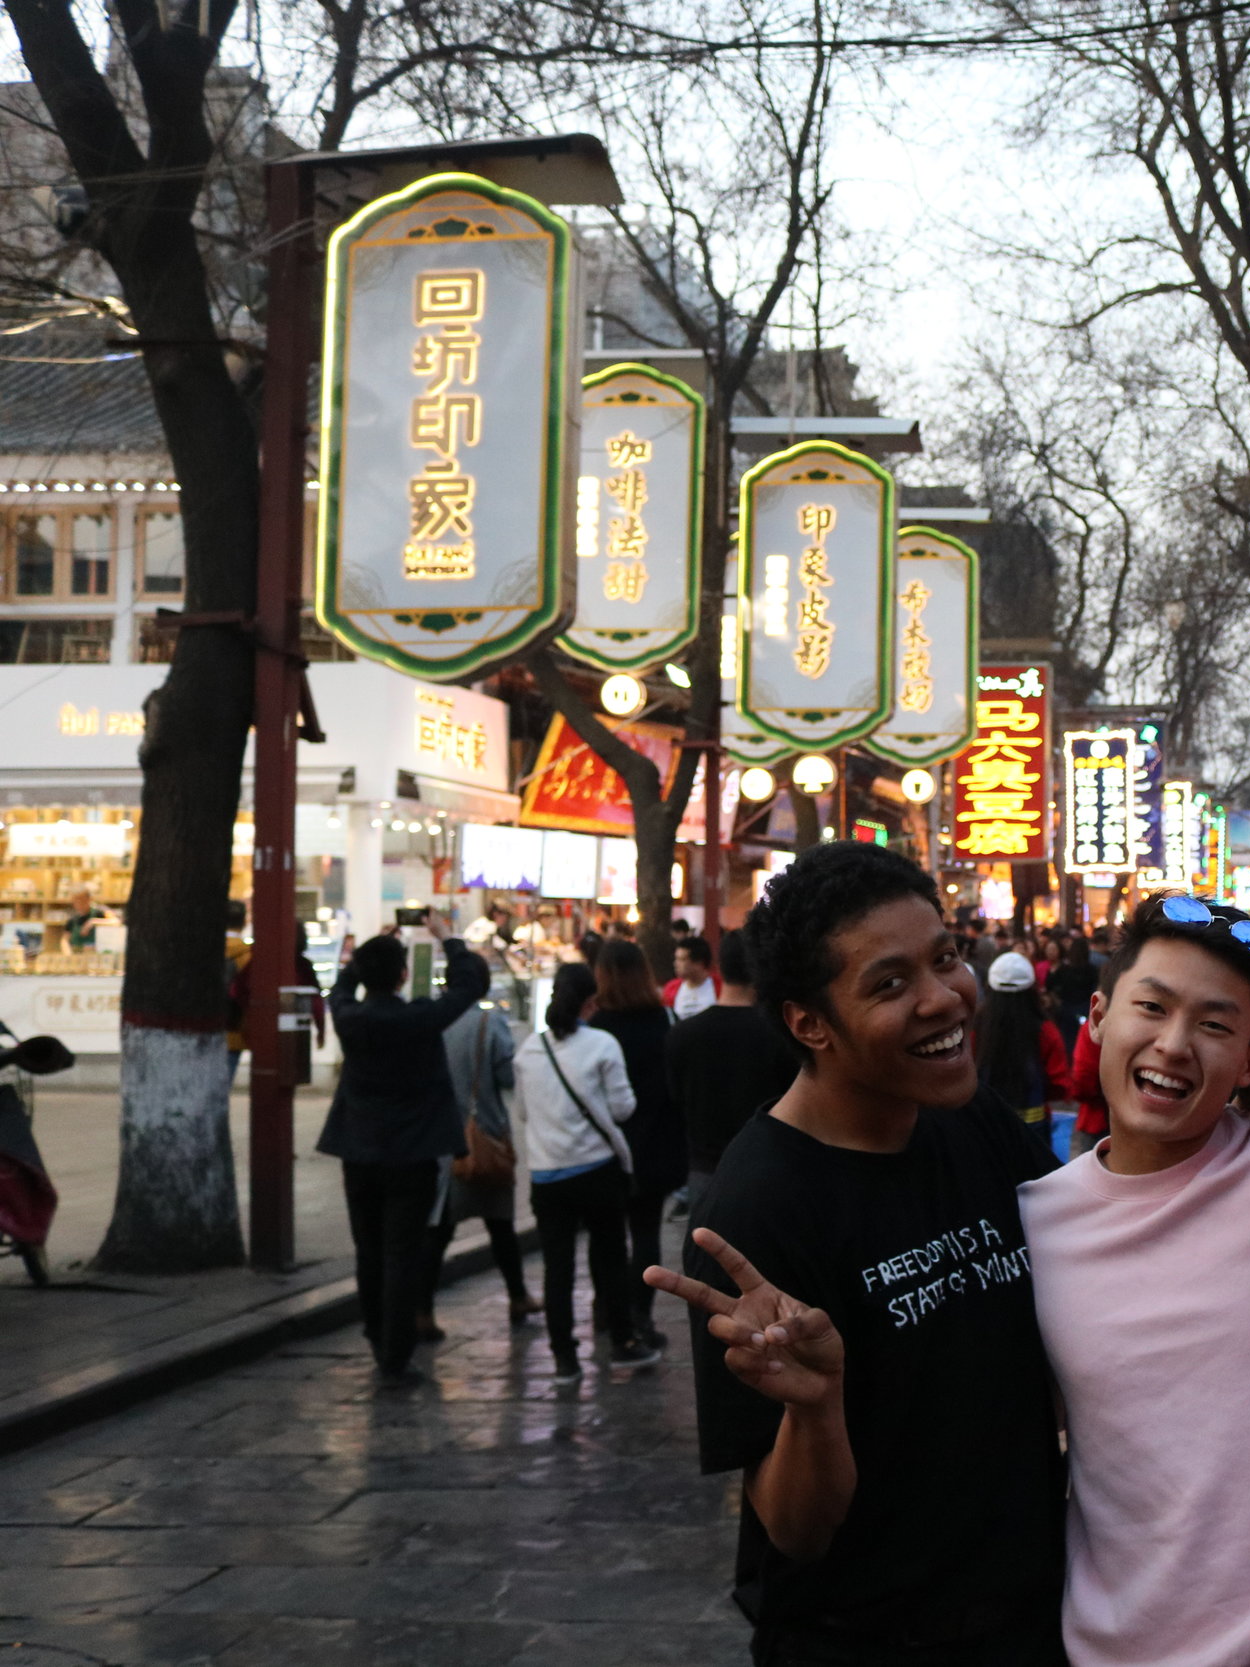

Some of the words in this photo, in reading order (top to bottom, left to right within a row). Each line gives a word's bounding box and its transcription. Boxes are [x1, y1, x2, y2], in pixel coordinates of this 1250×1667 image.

[411, 269, 484, 541] 回坊印家
[604, 430, 652, 604] 咖啡法甜
[979, 1219, 1003, 1247] A
